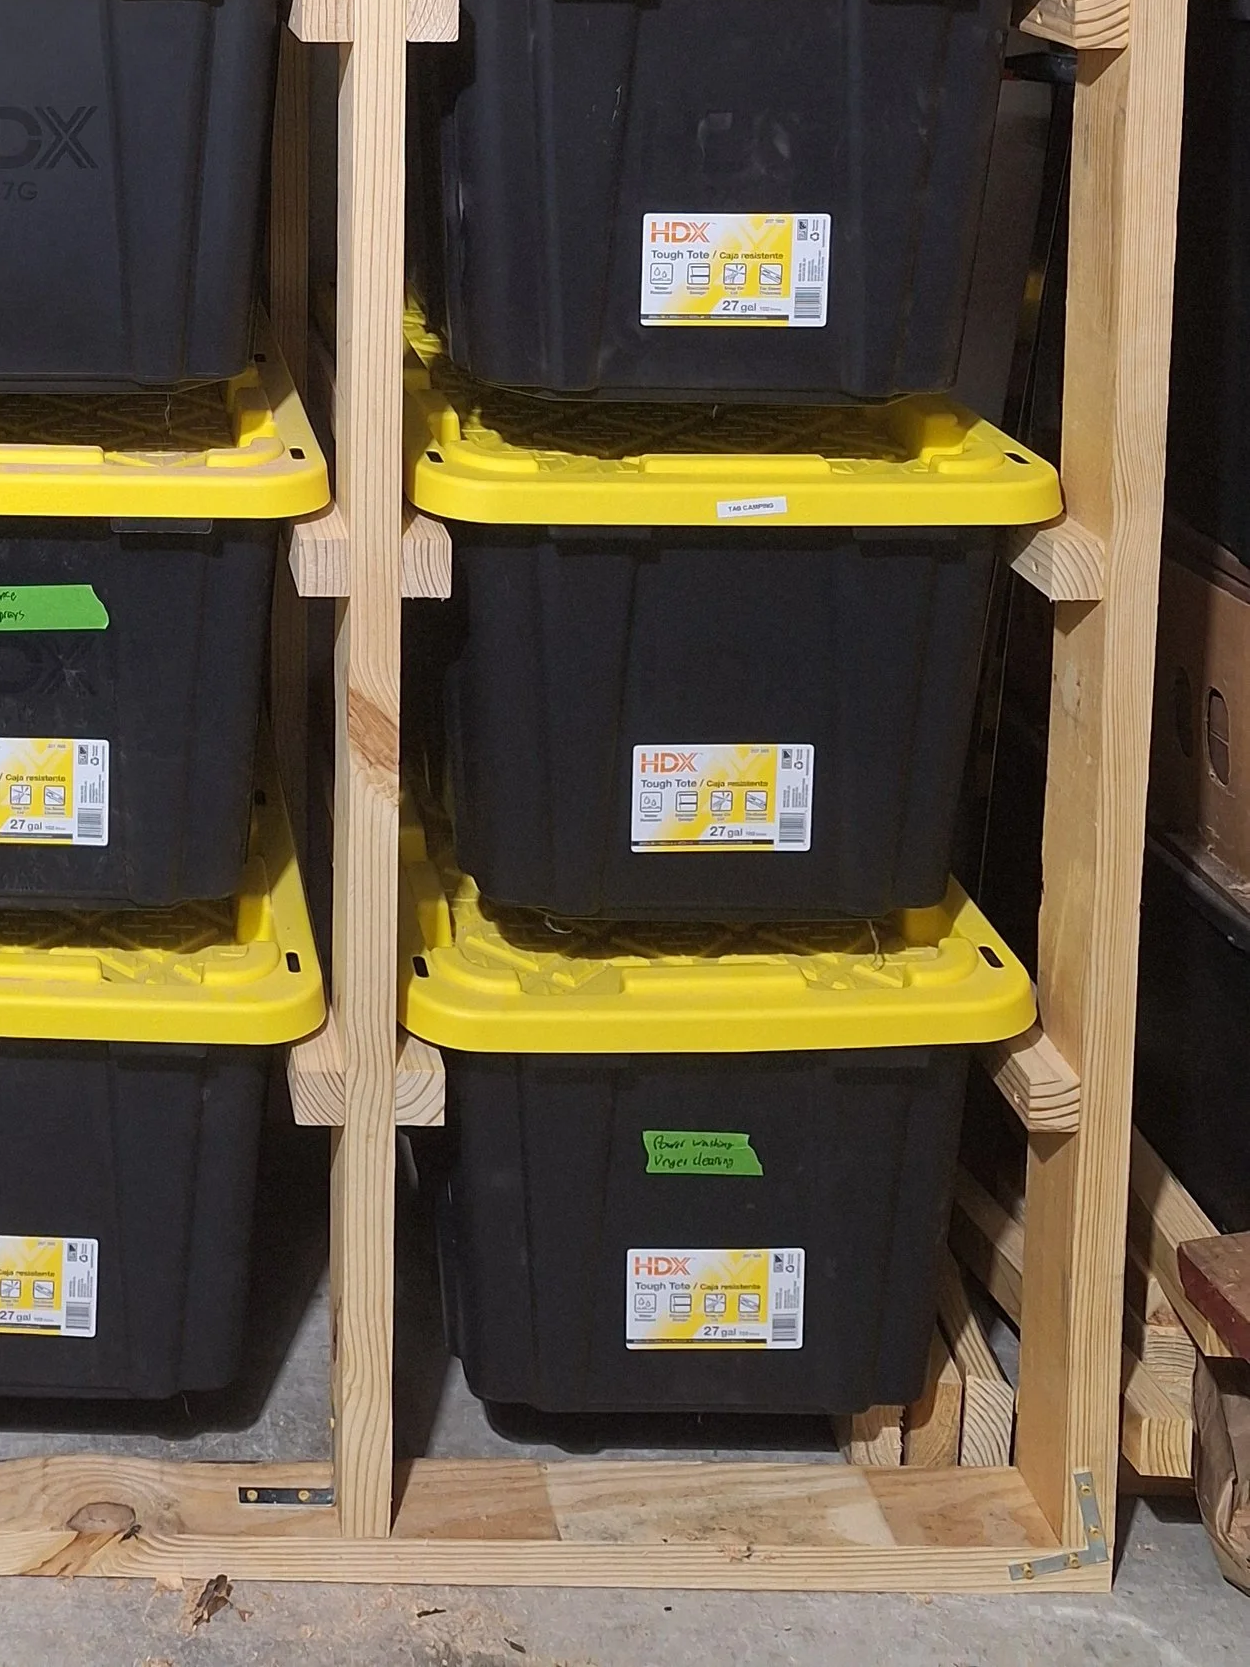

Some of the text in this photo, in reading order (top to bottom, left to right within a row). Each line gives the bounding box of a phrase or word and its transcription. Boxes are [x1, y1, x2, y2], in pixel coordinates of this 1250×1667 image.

[651, 222, 710, 243] HDX
[651, 250, 683, 260] Tough
[687, 250, 709, 259] Tote
[719, 252, 739, 260] Caja
[722, 300, 739, 311] 27
[741, 303, 756, 313] gal
[641, 753, 698, 773] HDX
[5, 774, 23, 782] Caja
[641, 779, 672, 789] Tough
[675, 779, 697, 788] Tote
[706, 780, 725, 788] Caja
[10, 819, 42, 831] 27 gal
[710, 826, 743, 838] 27 gal
[635, 1257, 691, 1276] HDX
[635, 1282, 666, 1291] Tough
[669, 1282, 691, 1290] Tote
[700, 1283, 718, 1291] Caja
[0, 1311, 31, 1322] 27 gal
[704, 1327, 719, 1336] 27
[721, 1328, 737, 1337] gal
